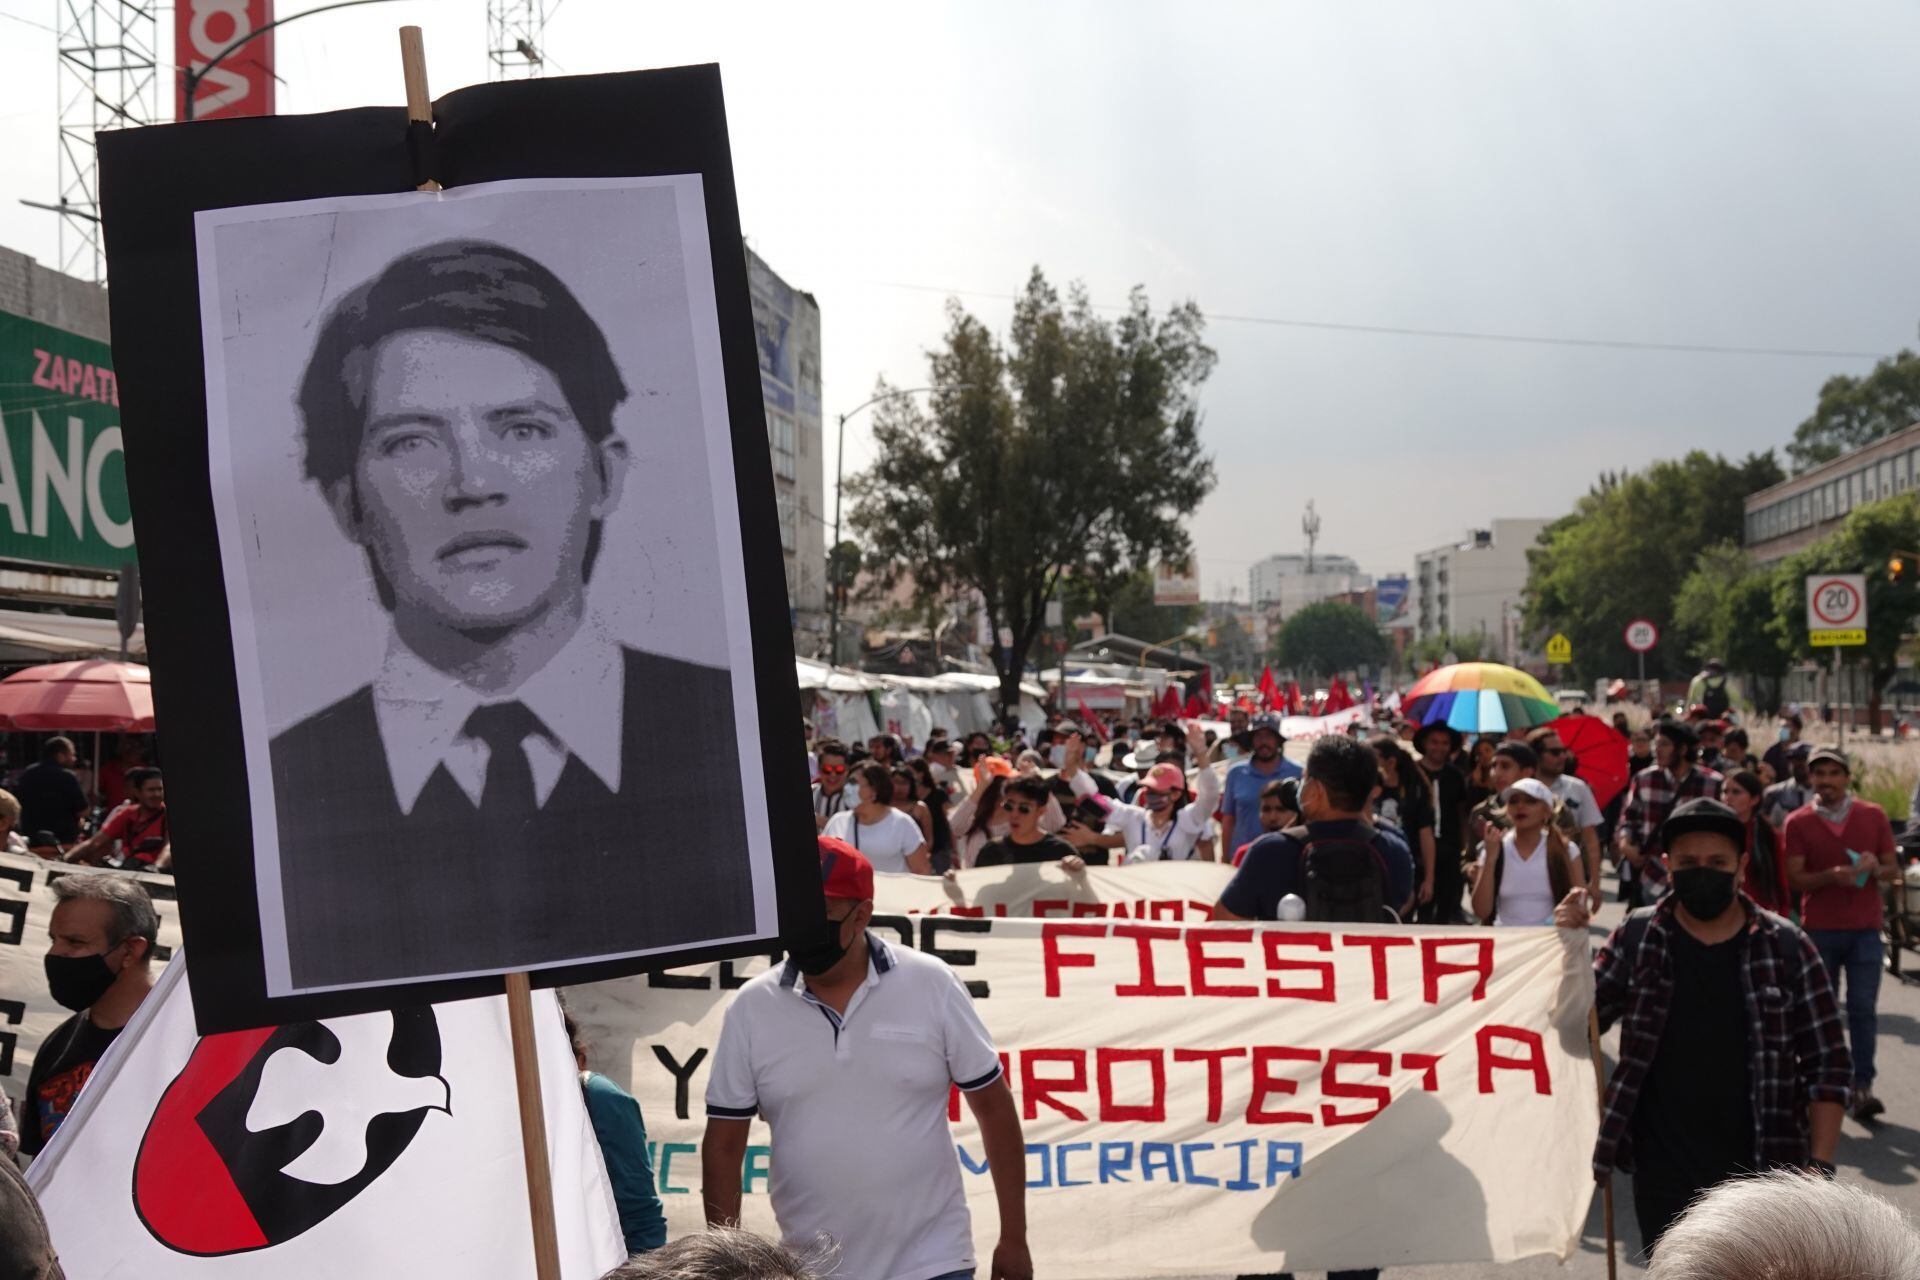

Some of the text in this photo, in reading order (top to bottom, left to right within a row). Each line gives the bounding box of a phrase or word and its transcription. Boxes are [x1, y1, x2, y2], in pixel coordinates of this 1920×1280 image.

[1825, 589, 1849, 609] 20
[1041, 923, 1495, 1004] FIESTA
[651, 1044, 709, 1120] Y
